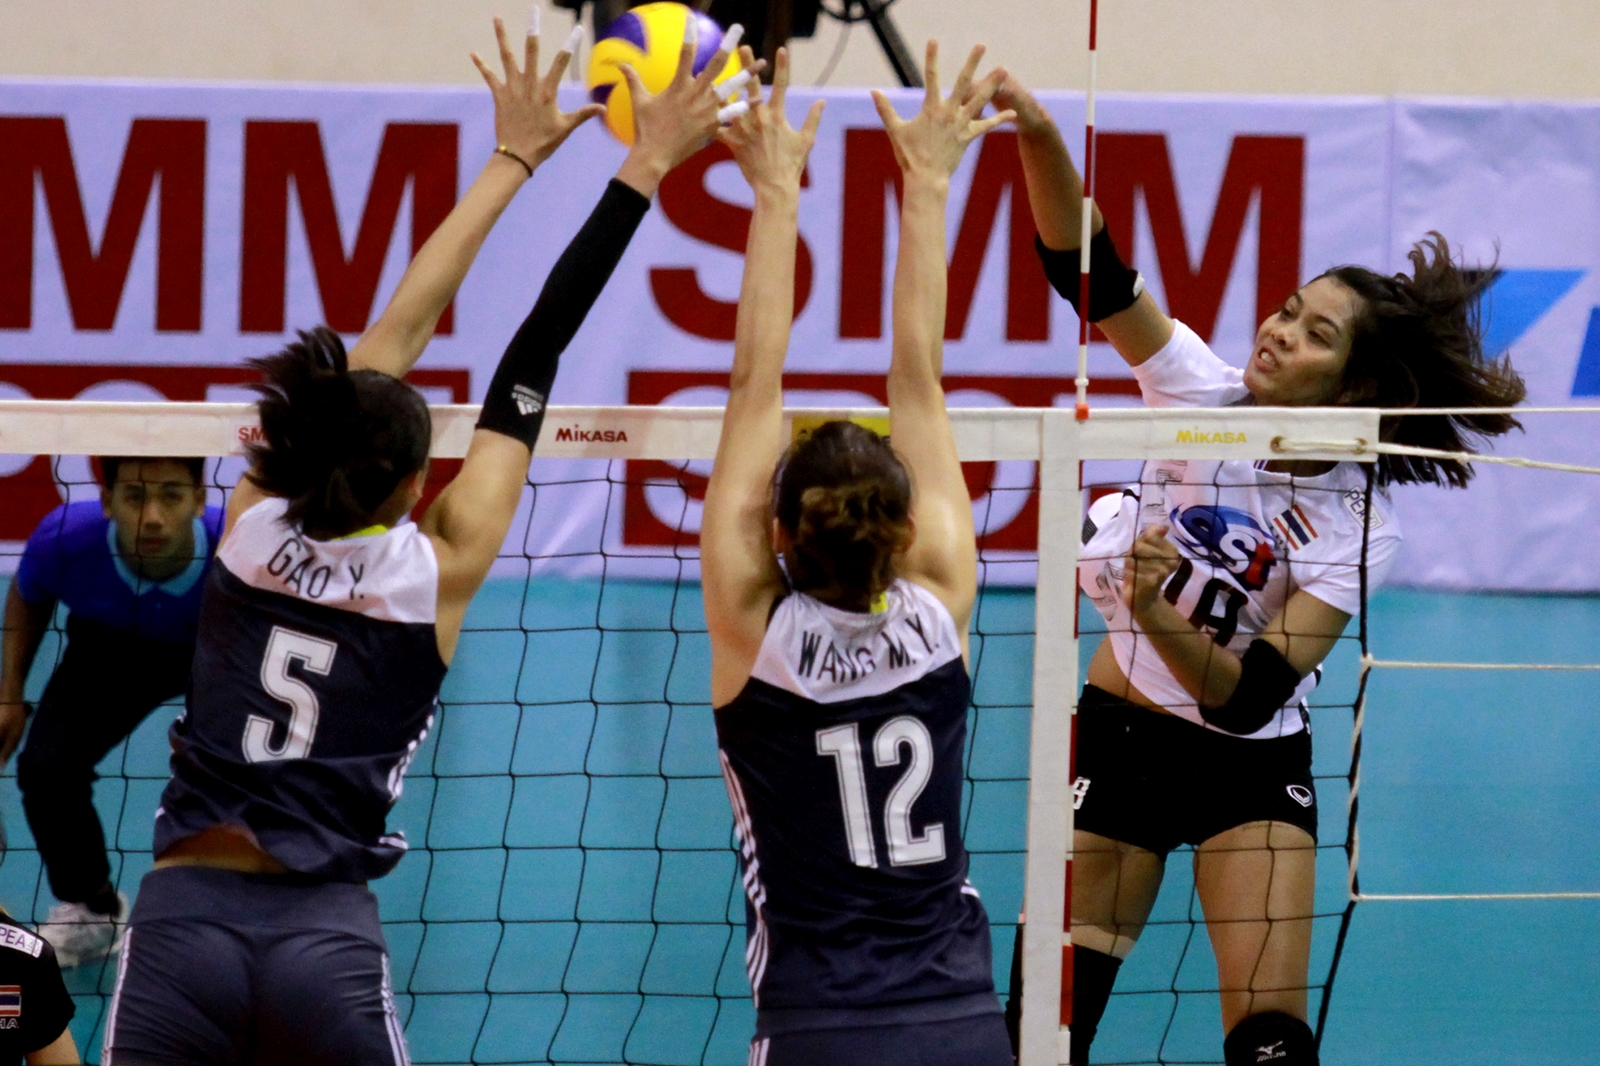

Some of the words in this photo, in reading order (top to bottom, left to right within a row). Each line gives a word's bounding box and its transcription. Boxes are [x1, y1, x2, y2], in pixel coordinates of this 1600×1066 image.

[267, 537, 331, 599] GAO
[349, 563, 365, 600] Y.
[241, 625, 338, 763] 5
[798, 630, 876, 683] WANG
[815, 715, 946, 869] 12
